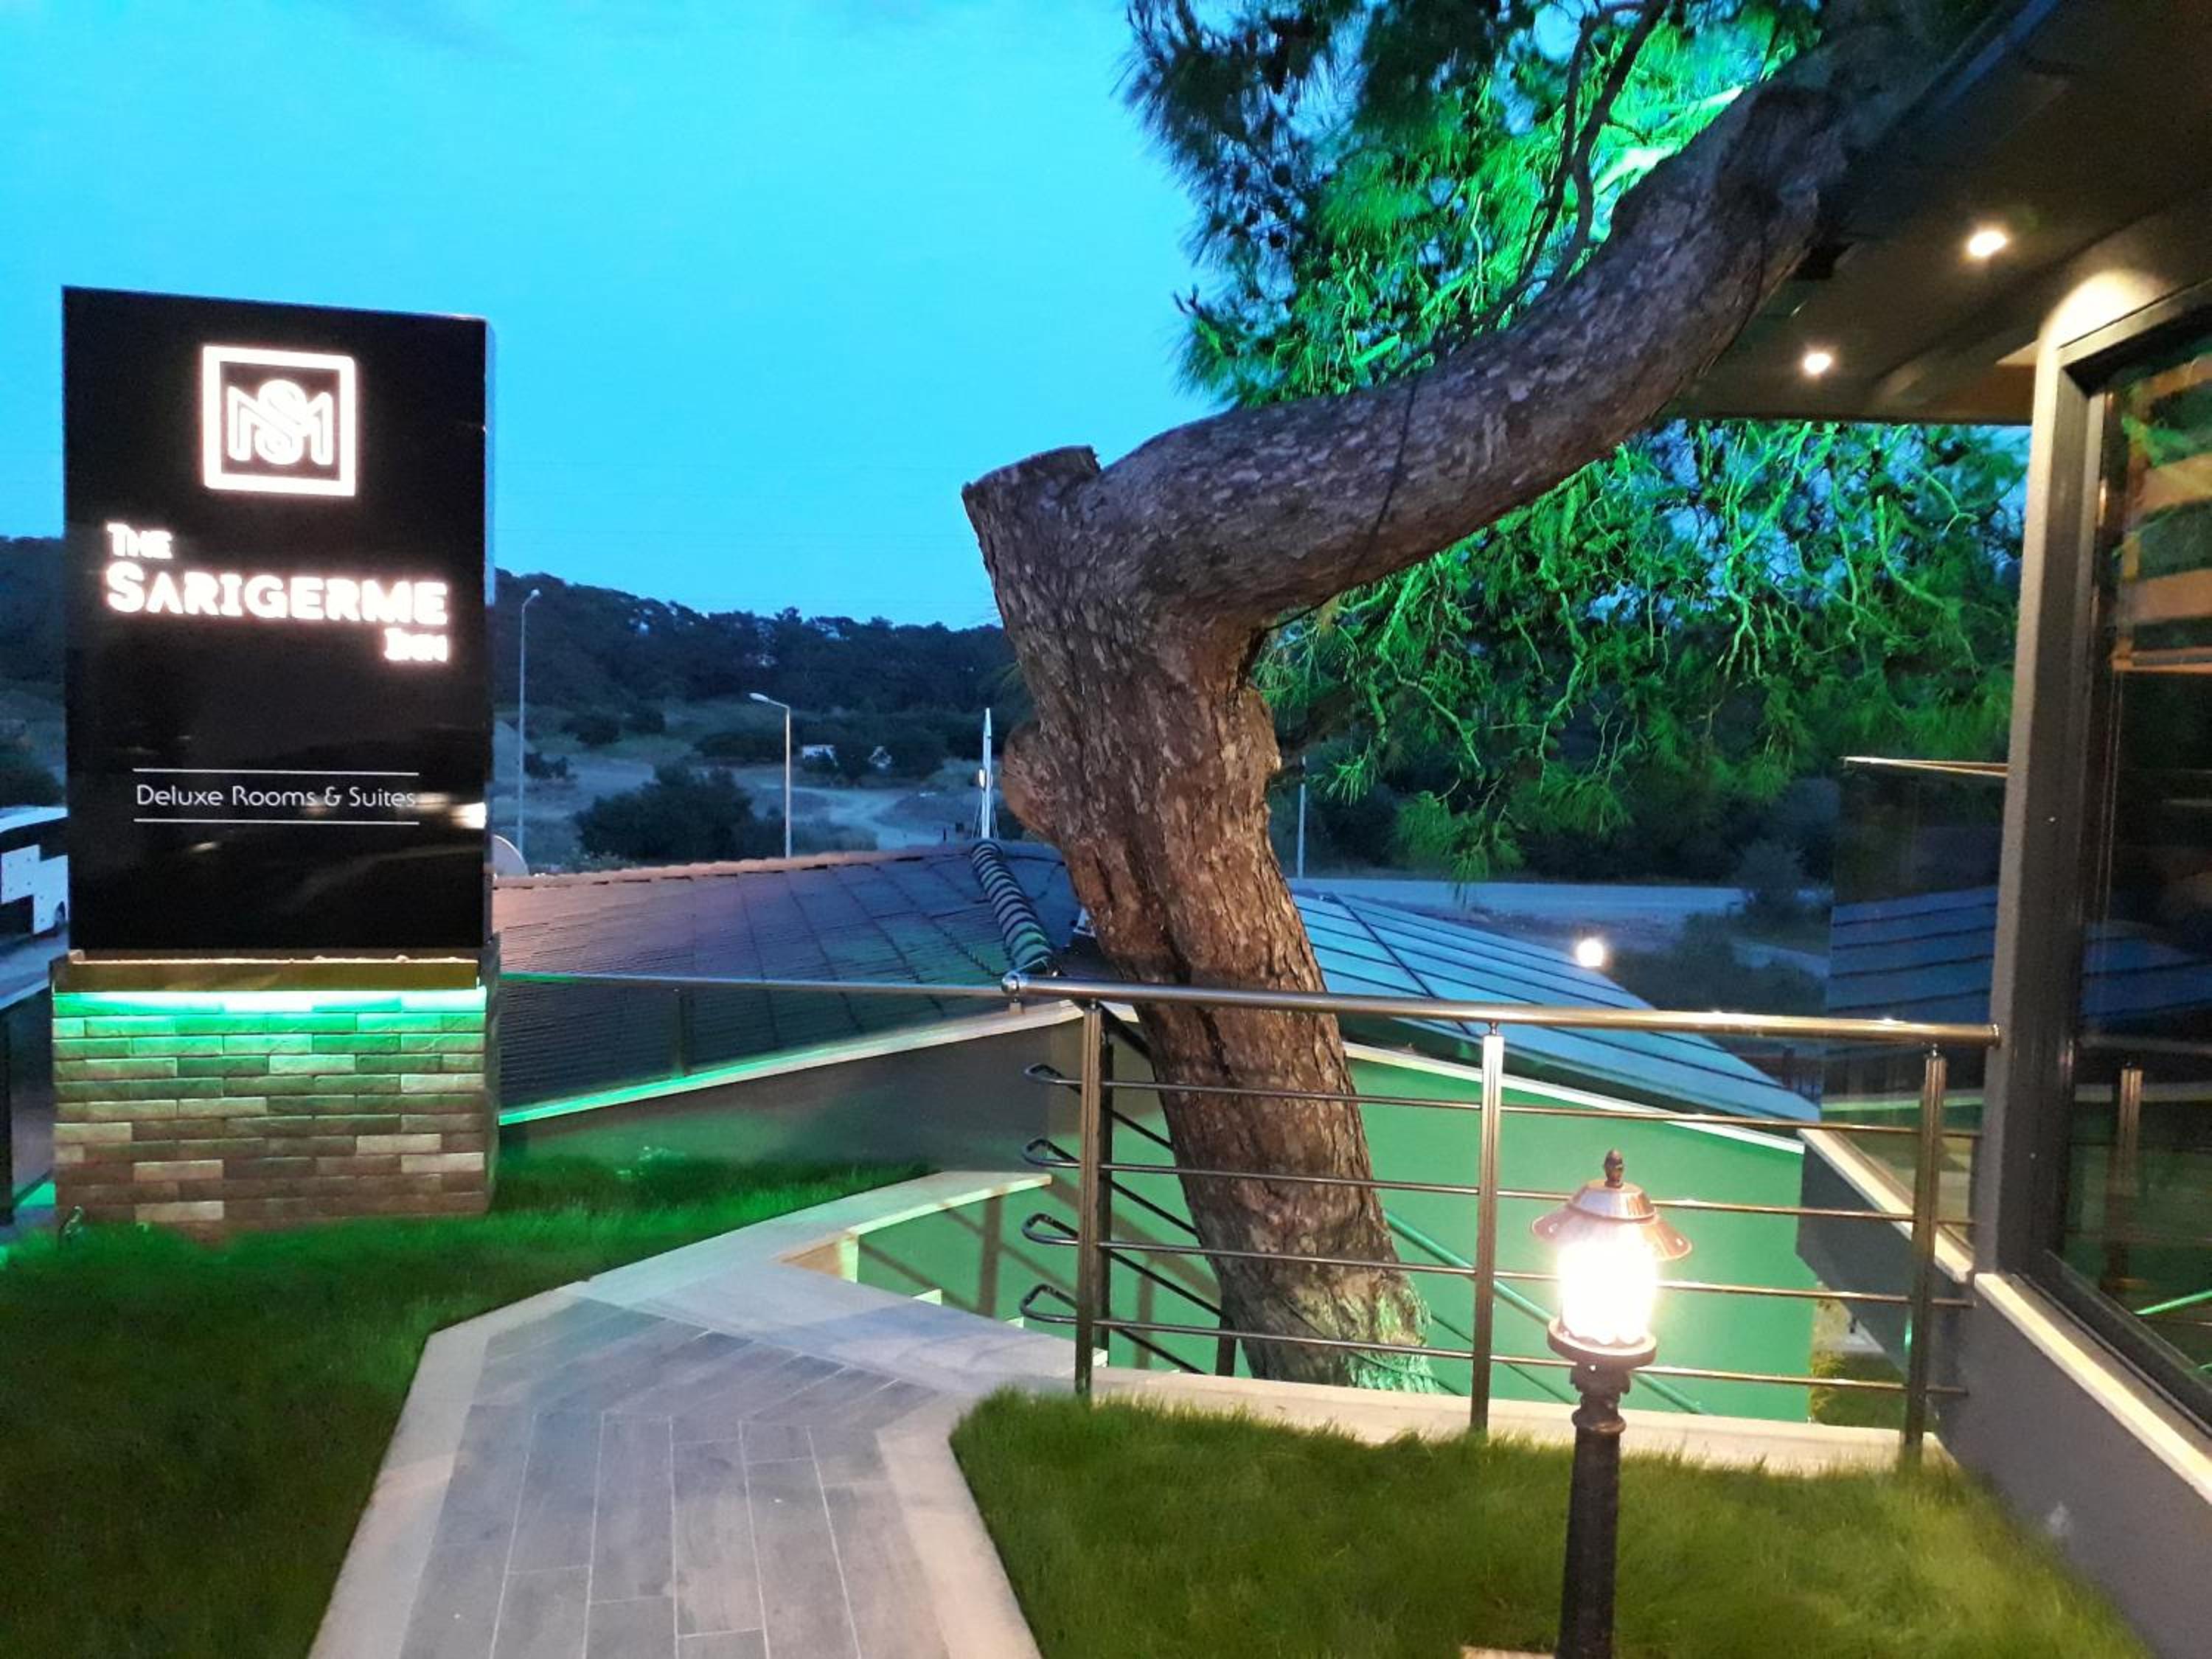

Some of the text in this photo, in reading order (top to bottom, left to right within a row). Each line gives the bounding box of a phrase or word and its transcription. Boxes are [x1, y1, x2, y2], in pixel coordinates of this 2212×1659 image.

[105, 561, 448, 626] SARIGERME
[136, 784, 416, 807] Deluxe Rooms & Suites
